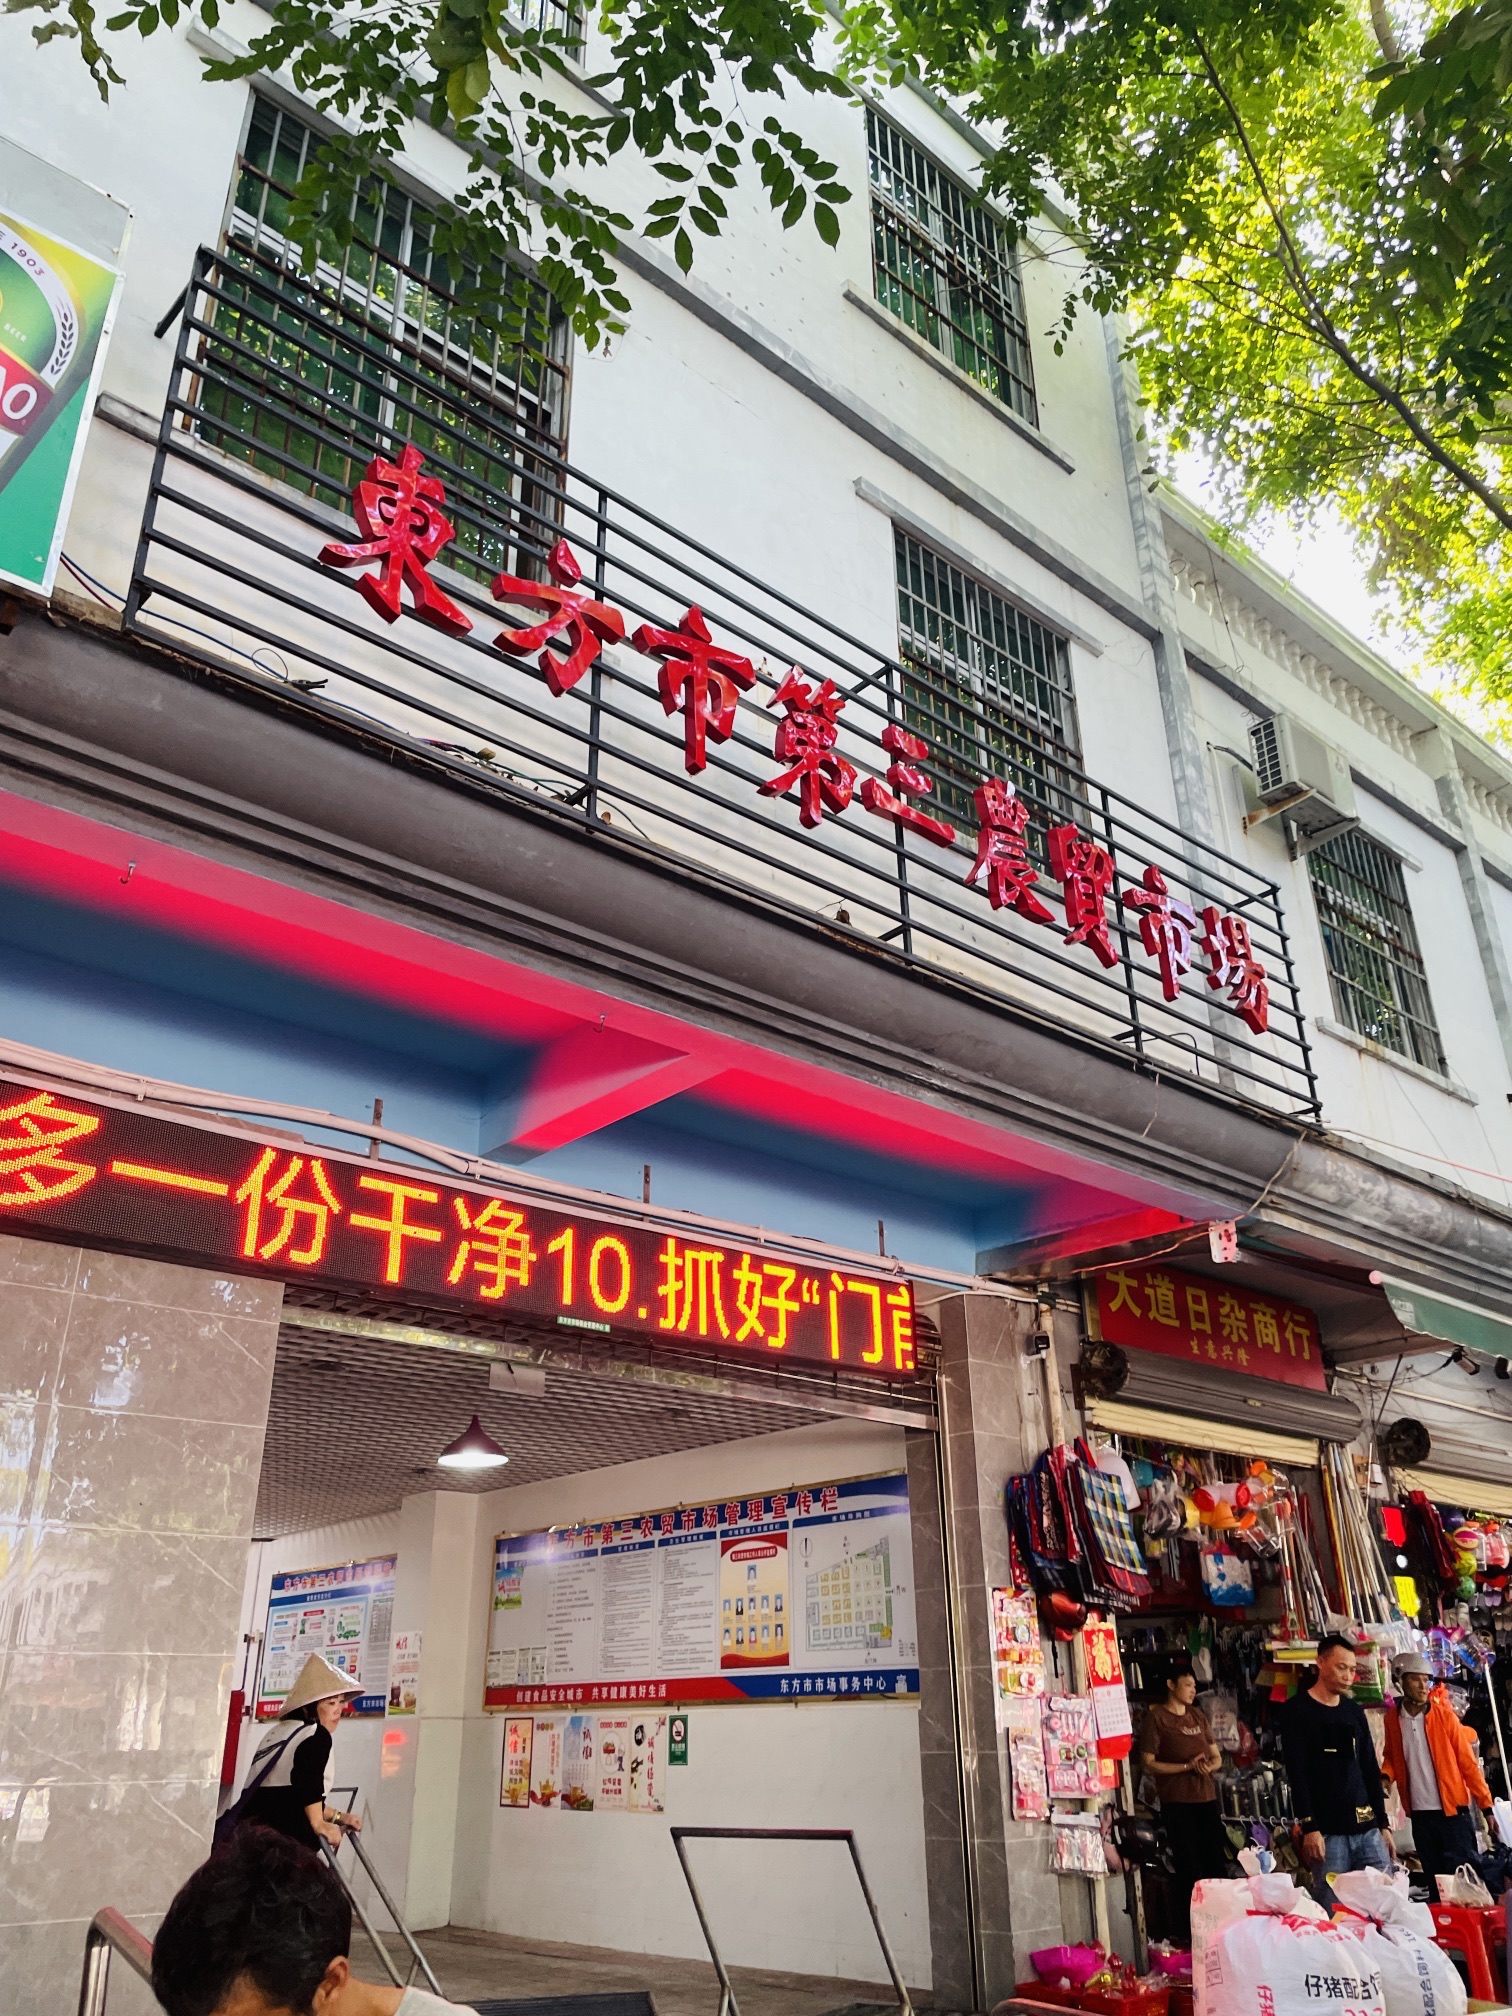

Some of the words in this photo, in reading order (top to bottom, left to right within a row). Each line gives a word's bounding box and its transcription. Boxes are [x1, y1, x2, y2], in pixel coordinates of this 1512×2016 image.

[11, 242, 45, 276] 1903
[1105, 1269, 1312, 1361] 大道日杂商行
[546, 1486, 839, 1554] 东方市第三农贸市场管理宣传栏
[591, 1683, 667, 1700] 共享健康美好生活
[779, 1675, 887, 1694] 东方市市场事务中心
